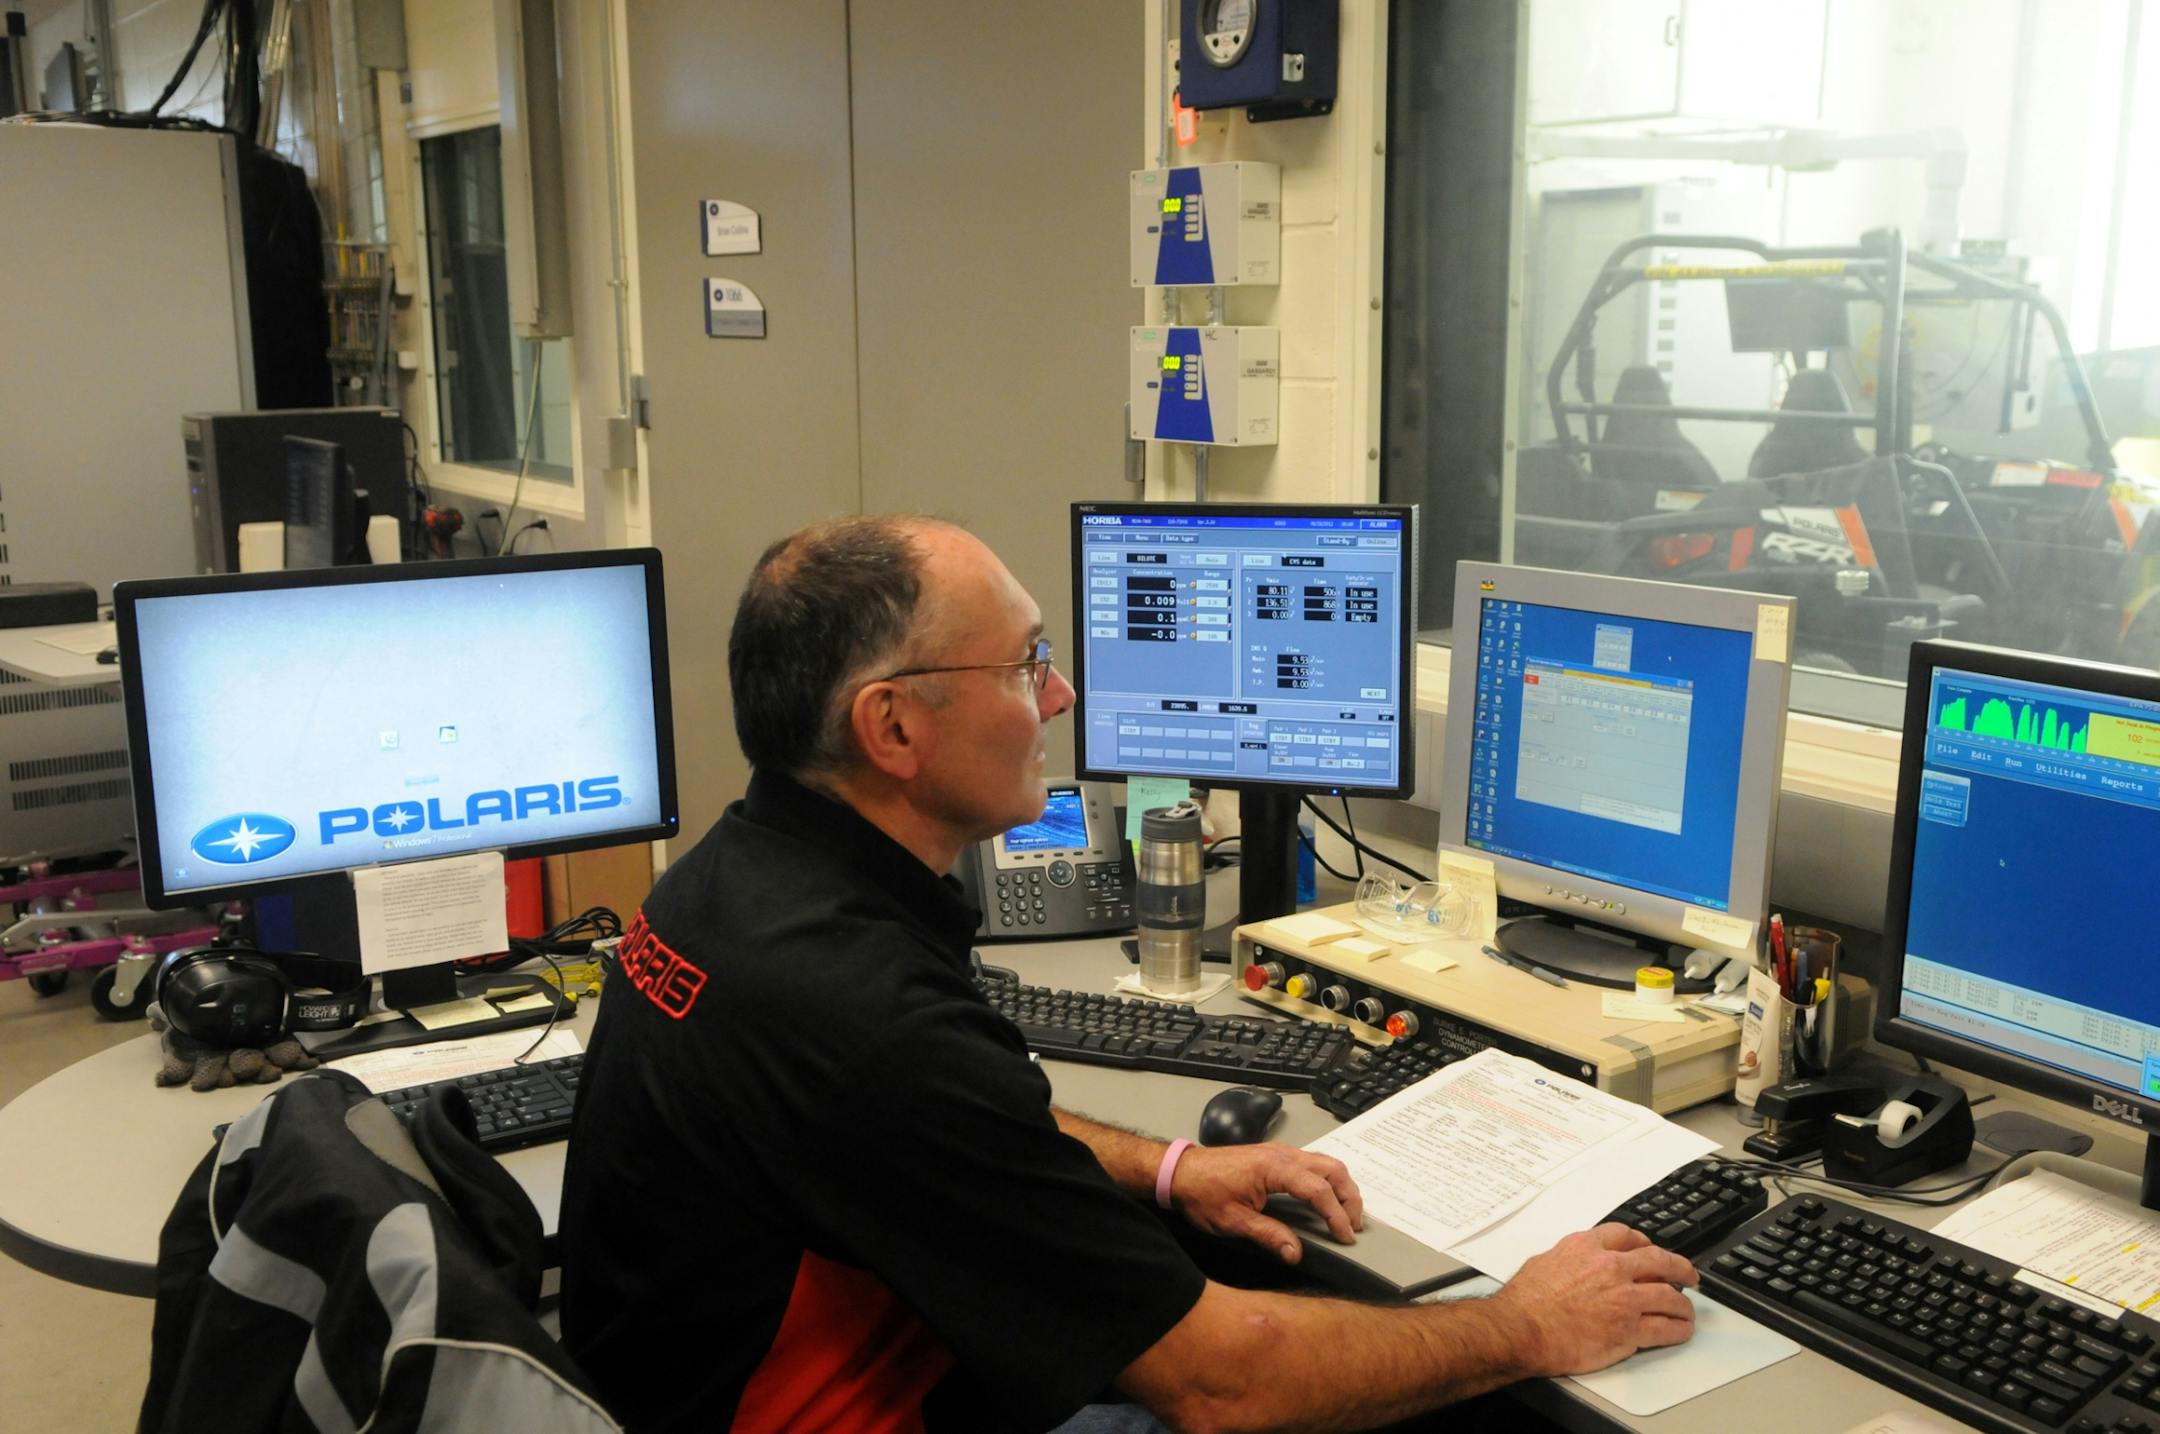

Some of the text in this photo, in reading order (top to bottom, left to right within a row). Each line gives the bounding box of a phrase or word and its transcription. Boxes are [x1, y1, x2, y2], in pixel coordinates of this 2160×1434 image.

[1083, 516, 1122, 525] HORIBA
[1761, 531, 1853, 566] RZR
[1170, 580, 1176, 588] 0
[1268, 587, 1288, 595] 80.11
[1145, 596, 1175, 605] 0.009
[1158, 613, 1175, 622] 0.1
[1271, 611, 1288, 619] 0.00
[1350, 614, 1371, 623] Empty
[1151, 631, 1175, 639] -0.0
[2127, 733, 2144, 744] 102
[1937, 743, 2143, 791] File Edit Run Utilities Reports
[319, 775, 623, 845] POLARIS
[393, 837, 432, 849] Windows
[298, 1010, 329, 1019] LEIGHT
[2092, 1094, 2143, 1124] DELL
